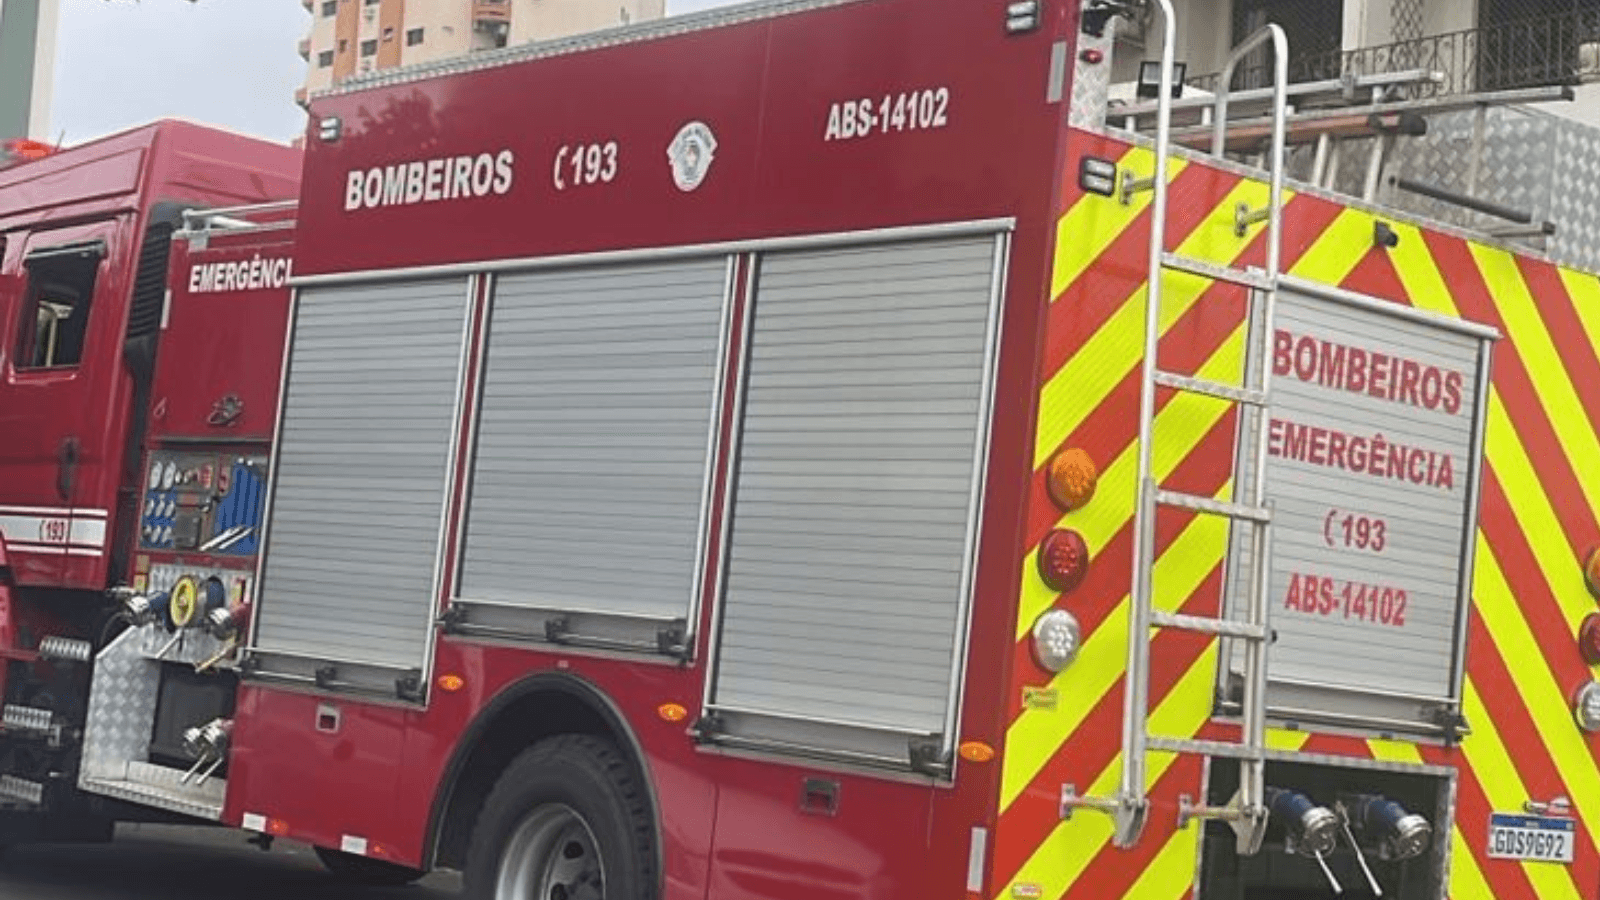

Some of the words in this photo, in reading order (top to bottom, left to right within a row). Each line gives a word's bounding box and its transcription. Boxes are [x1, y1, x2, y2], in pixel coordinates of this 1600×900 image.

[824, 87, 949, 141] ABS-14102
[345, 150, 513, 211] BOMBEIROS
[571, 142, 617, 185] 193
[1272, 329, 1462, 415] BOMBEIROS
[1267, 419, 1454, 490] EMERGÊNCIA
[46, 521, 64, 541] 193
[1342, 515, 1386, 551] 193
[1285, 572, 1407, 627] ABS-14102
[1495, 829, 1564, 858] GDS9G92
